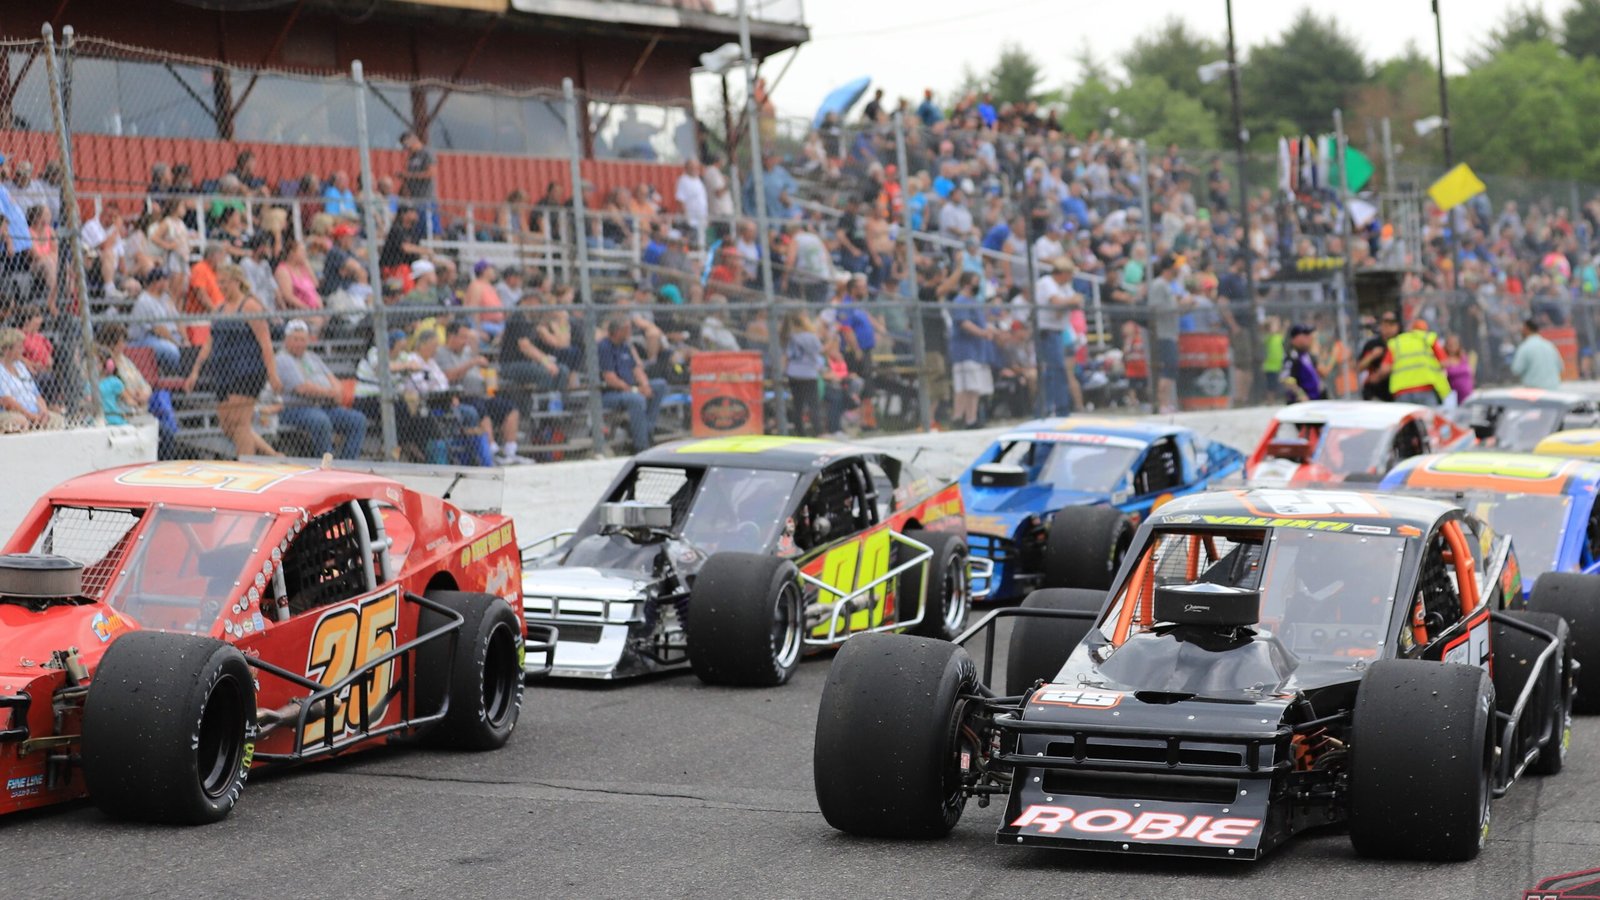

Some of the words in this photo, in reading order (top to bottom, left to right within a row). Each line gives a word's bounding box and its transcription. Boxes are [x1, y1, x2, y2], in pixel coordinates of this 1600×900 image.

[1203, 515, 1353, 532] VALENTI
[303, 586, 399, 749] 25
[1010, 804, 1261, 845] ROBIE
